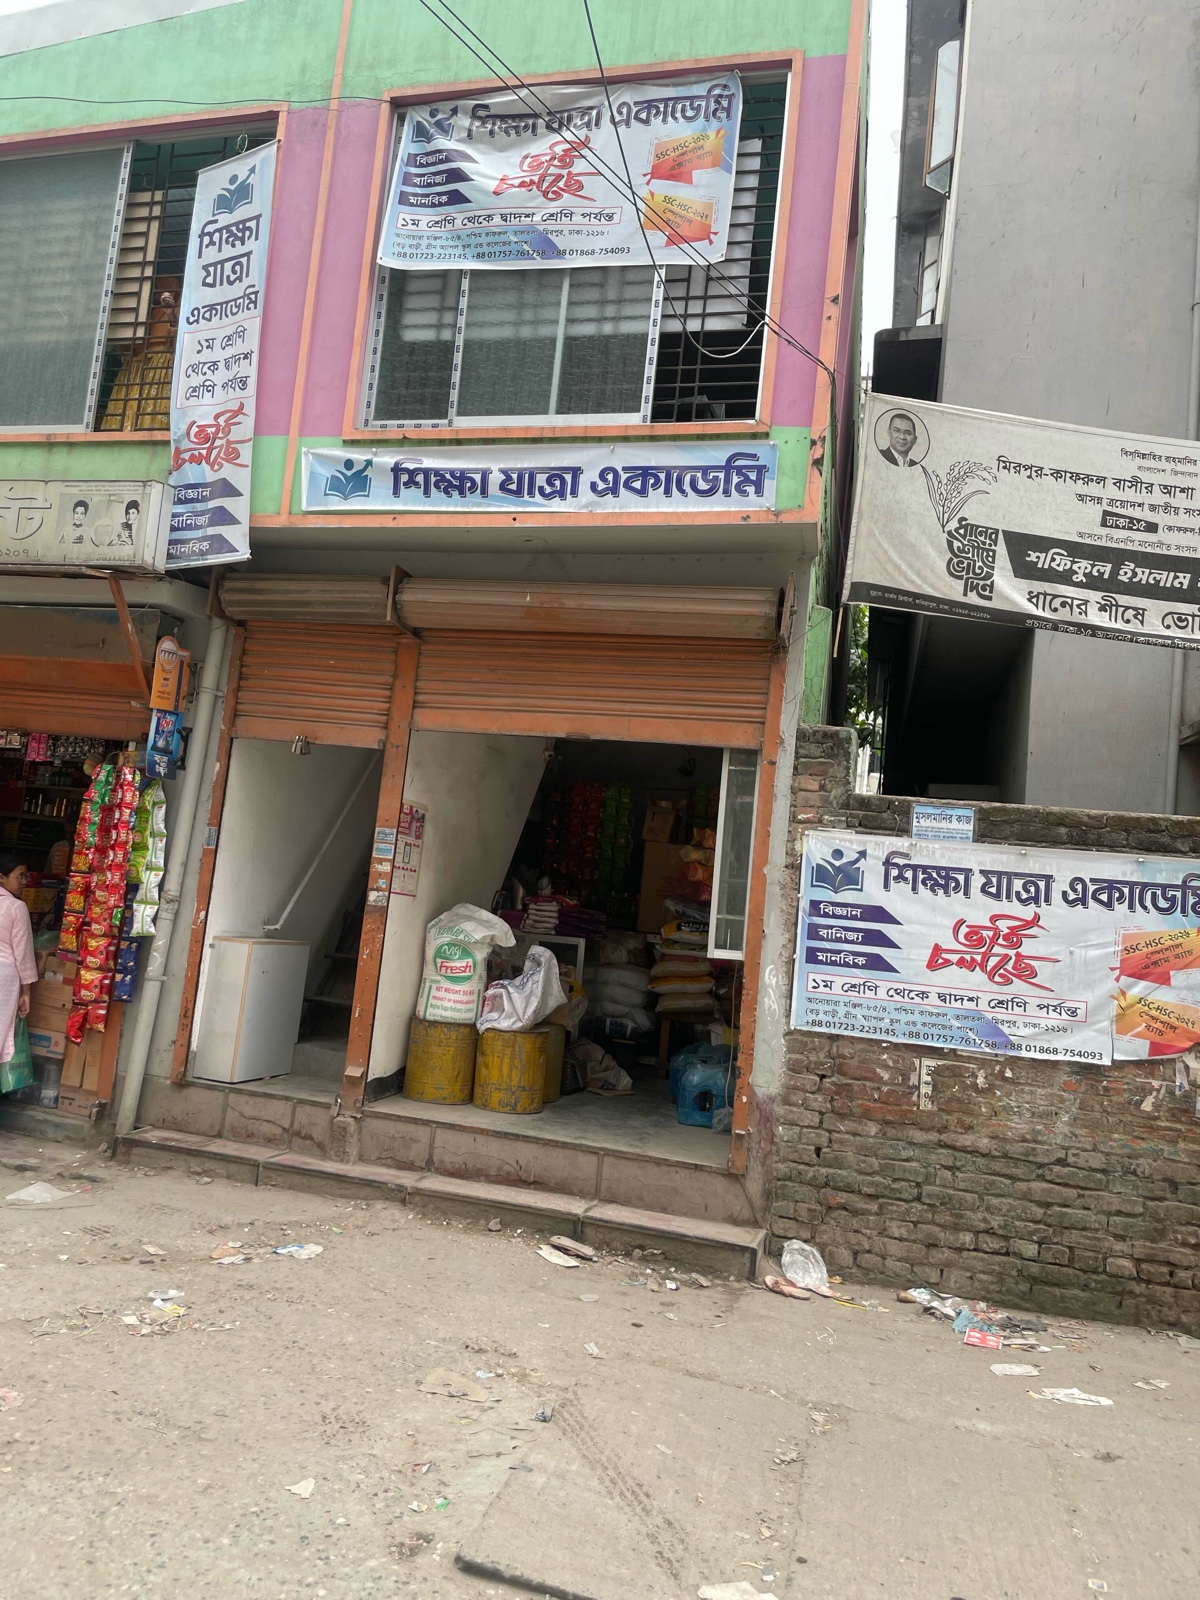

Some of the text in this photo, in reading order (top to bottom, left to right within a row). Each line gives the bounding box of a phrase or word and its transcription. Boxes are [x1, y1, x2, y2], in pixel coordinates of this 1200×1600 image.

[467, 83, 736, 141] শিক্ষা যাত্রা একাডেমি
[416, 151, 448, 166] বিজ্ঞান
[492, 134, 604, 202] ভর্তি চলছে
[412, 172, 448, 186] বানিজ্য
[408, 194, 449, 206] মানবিক
[401, 208, 617, 229] ১ম শ্রেণি থেকে দ্বাদশ শ্রেণি পর্যন্ত
[197, 213, 262, 260] শিক্ষা
[391, 251, 408, 259] +88
[408, 251, 469, 260] 01723-223145,
[487, 249, 548, 259] 01757-761758,
[568, 246, 631, 256] 01868-754093
[201, 250, 253, 289] যাত্রা
[186, 284, 259, 325] একাডেমি
[197, 325, 247, 355] ১ম শ্রেণি
[185, 350, 254, 379] থেকে দ্বাদশ
[185, 371, 250, 401] শ্রেণি পর্যন্ত
[186, 401, 250, 447] ভর্তি
[172, 437, 252, 473] চলছে
[391, 452, 770, 501] শিক্ষা যাত্রা একাডেমি
[996, 455, 1196, 501] মিরপুর-কাফরুল বাসীর আশা
[174, 486, 212, 502] বিজ্ঞান
[1075, 493, 1103, 507] আসন্ন
[1106, 497, 1145, 512] ত্রয়োদশ
[1147, 501, 1180, 517] জাতীয়
[171, 513, 210, 528] বানিজ্য
[1105, 515, 1200, 536] ঢাকা-১৫ (কাফরুল-
[168, 540, 211, 556] মানবিক
[1076, 531, 1103, 543] আসনে
[1105, 533, 1136, 547] বিএনপি
[1138, 539, 1172, 552] মনোনীত
[1025, 548, 1191, 589] শফিকুল ইসলাম
[1026, 590, 1200, 635] ধানের শীষে ভো
[915, 810, 972, 826] মুসলমানির কাজ
[882, 850, 973, 898] শিক্ষা
[979, 868, 1055, 907] যাত্রা
[818, 903, 862, 919] বিজ্ঞান
[817, 927, 866, 944] বানিজ্য
[953, 911, 1050, 953] ভর্তি
[1124, 929, 1190, 955] SSC-HSC-২০২৬
[816, 950, 867, 967] মানবিক
[1145, 942, 1184, 960] স্পেশাল
[439, 960, 472, 975] Fresh
[925, 944, 1061, 992] চলছে
[805, 996, 841, 1008] আনোয়ারা
[894, 1005, 915, 1016] পশ্চিম
[991, 1016, 1019, 1029] মিরপুর,
[811, 978, 1081, 1018] ১ম শ্রেণি থেকে দ্বাদশ শ্রেণি পর্যন্ত
[805, 1006, 820, 1017] (বড়
[920, 1020, 953, 1032] কলেজের
[1136, 997, 1196, 1029] SSC-HSC-২০২৭
[1139, 1010, 1178, 1033] স্পেশাল
[805, 1019, 1103, 1061] +88 01723-223145, +88 01757-761758, +88 01868-754093
